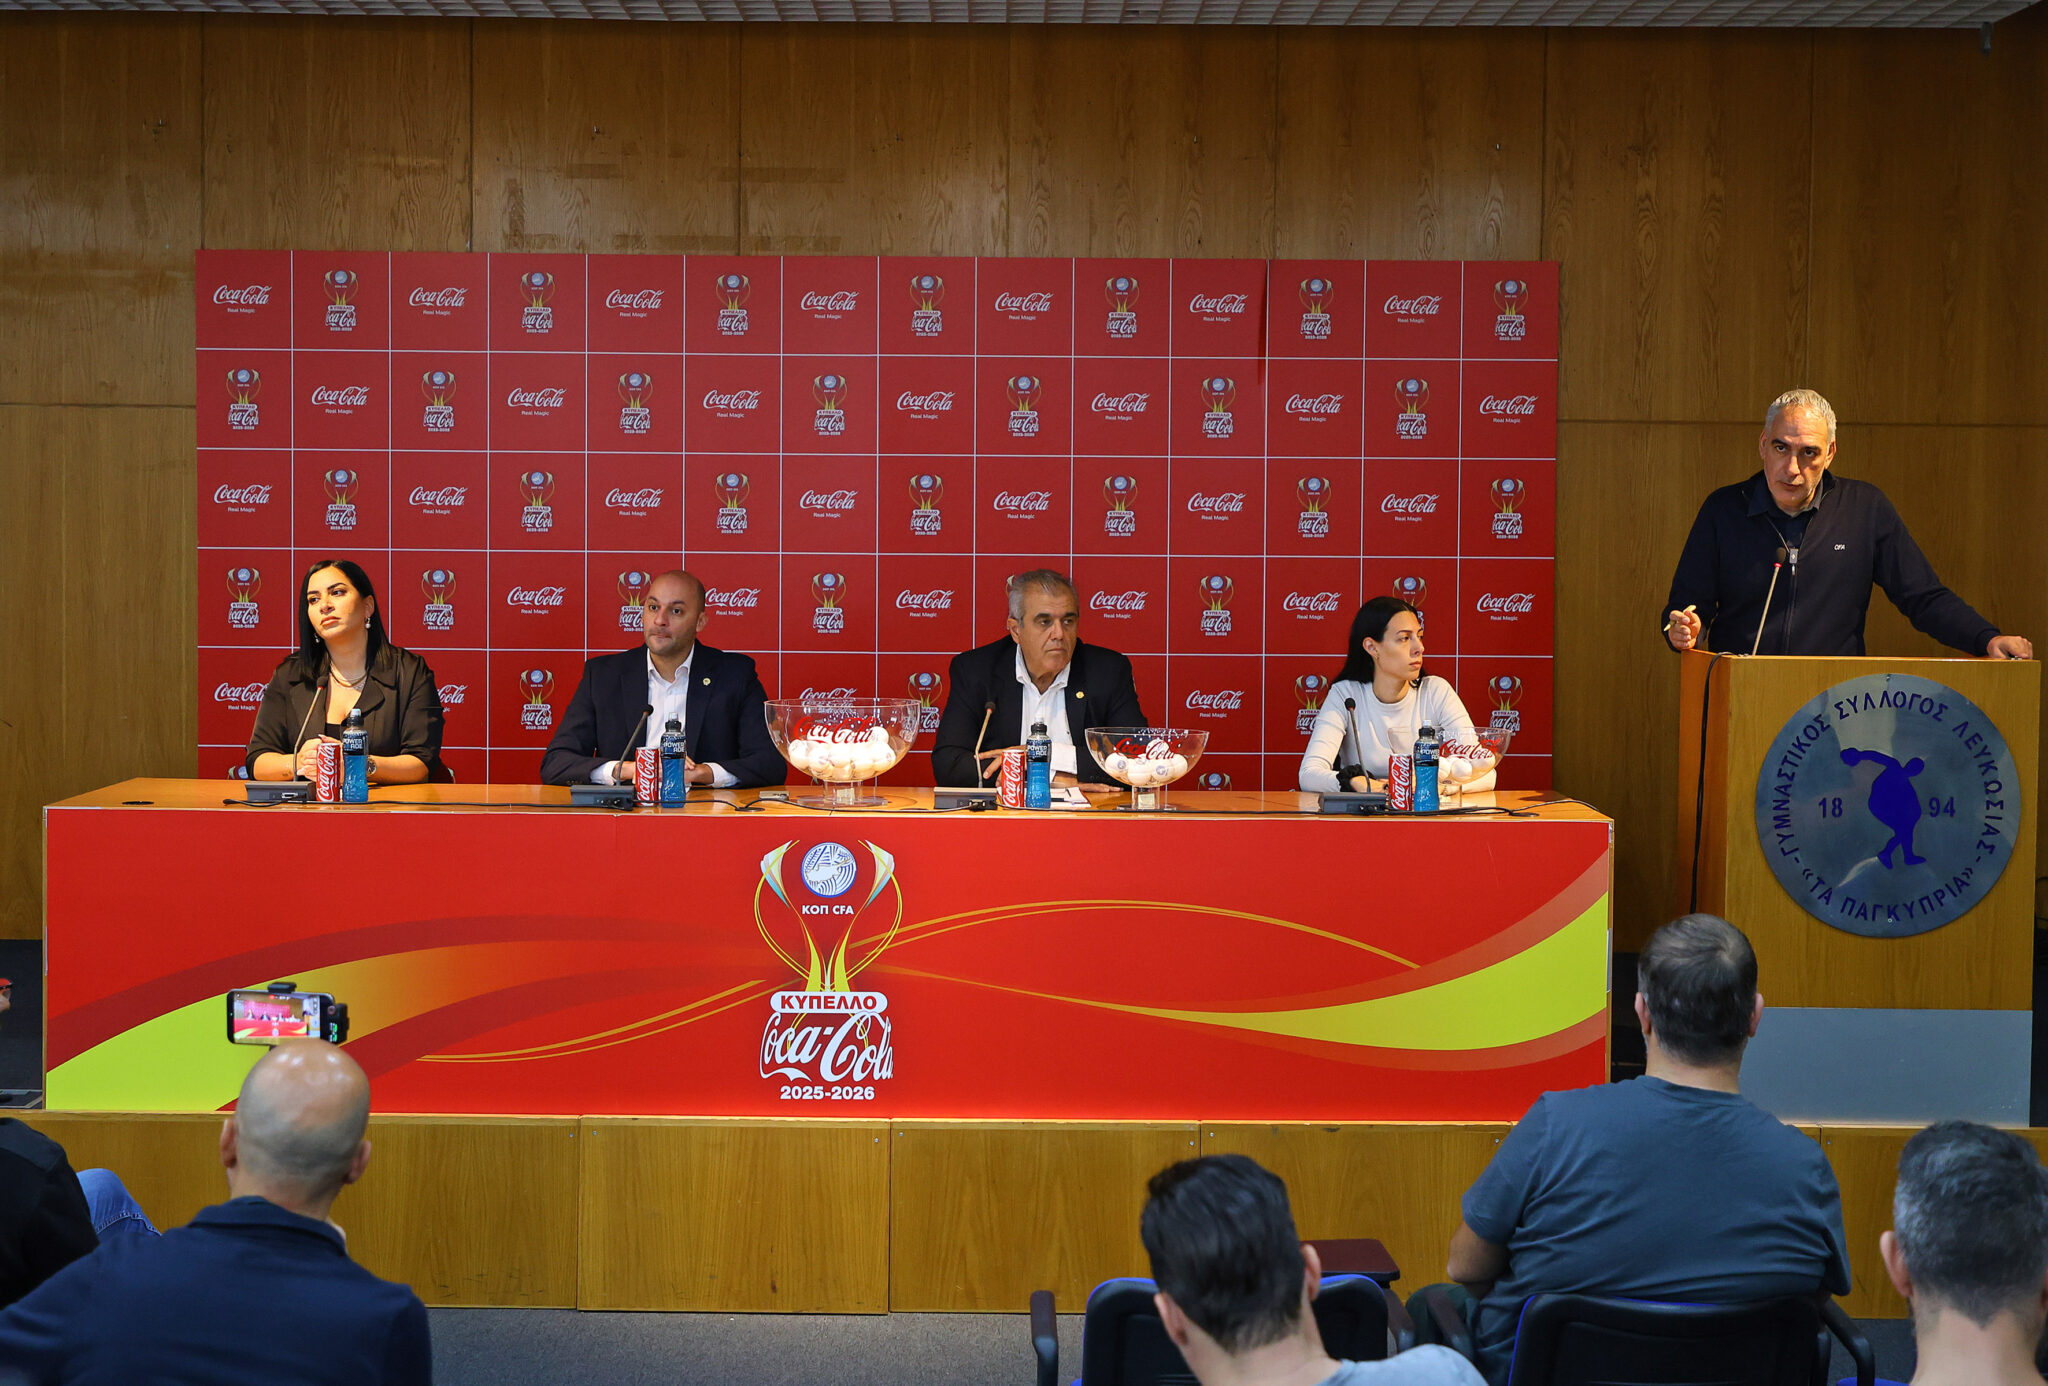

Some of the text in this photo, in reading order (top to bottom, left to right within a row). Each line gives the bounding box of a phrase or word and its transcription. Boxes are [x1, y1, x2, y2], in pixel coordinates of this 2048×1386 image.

[213, 285, 272, 304] Coca-Cola
[409, 287, 468, 306] Coca-Cola
[606, 289, 664, 309] Coca-Cola
[801, 291, 859, 310] Coca-Cola
[995, 292, 1053, 311] Coca-Cola
[1190, 294, 1248, 313] Coca-Cola
[1384, 295, 1441, 314] Coca-Cola
[312, 386, 370, 405] Coca-Cola
[508, 388, 566, 407] Coca-Cola
[703, 390, 761, 409] Coca-Cola
[897, 391, 955, 410] Coca-Cola
[1092, 393, 1150, 412] Coca-Cola
[1286, 394, 1344, 413] Coca-Cola
[1480, 396, 1537, 414] Coca-Cola
[214, 484, 272, 504] Coca-Cola
[409, 486, 468, 506] Coca-Cola
[605, 488, 664, 507] Coca-Cola
[800, 490, 858, 509] Coca-Cola
[994, 491, 1052, 510] Coca-Cola
[1188, 493, 1246, 512] Coca-Cola
[1381, 494, 1439, 512] Coca-Cola
[507, 586, 566, 605] Coca-Cola
[705, 588, 760, 607] Coca-Cola
[896, 590, 954, 608] Coca-Cola
[1090, 591, 1148, 610] Coca-Cola
[1283, 592, 1341, 611] Coca-Cola
[1477, 593, 1535, 612] Coca-Cola
[214, 683, 267, 702] Coca-Col
[1186, 690, 1244, 709] Coca-Cola
[1773, 690, 2003, 856] ΓΥΜΝΑΣΤΙΚΟΣ ΣΥΛΛΟΓΟΣ ΛΕΥΚΩΣΙΑΣ
[1818, 796, 1955, 818] 18 94
[801, 905, 854, 915] ΚΟΠ CFA
[780, 995, 877, 1010] ΚΥΠΕΛΛΟ
[780, 1086, 875, 1100] 2025-2026
